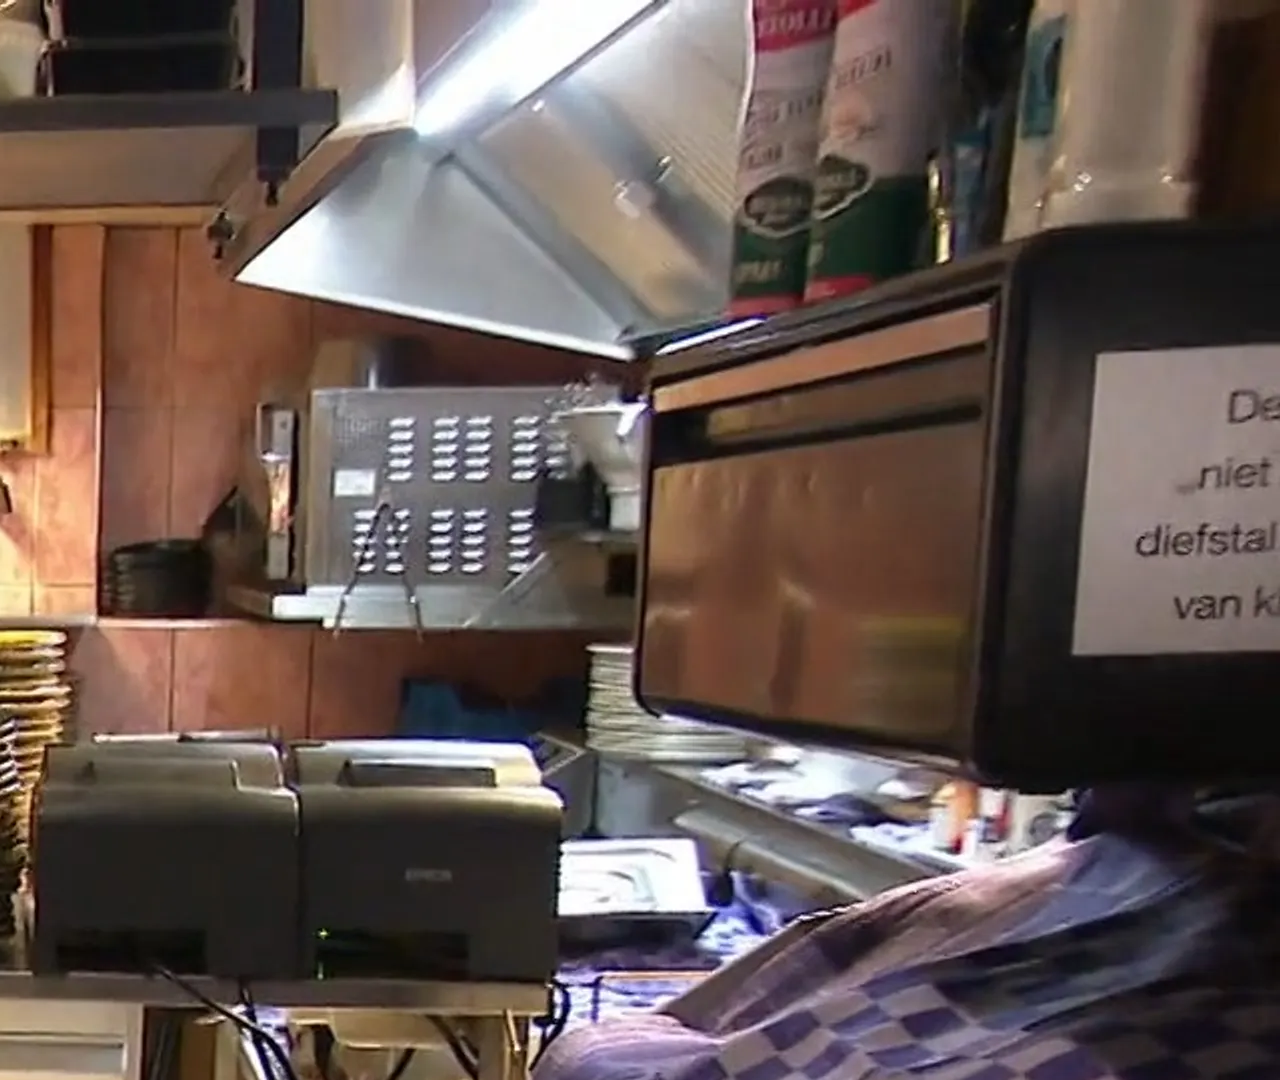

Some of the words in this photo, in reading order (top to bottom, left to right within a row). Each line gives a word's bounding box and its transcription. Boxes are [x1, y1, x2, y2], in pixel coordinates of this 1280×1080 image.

[1135, 521, 1278, 557] diefstal
[1173, 594, 1243, 619] van
[1253, 585, 1280, 618] k
